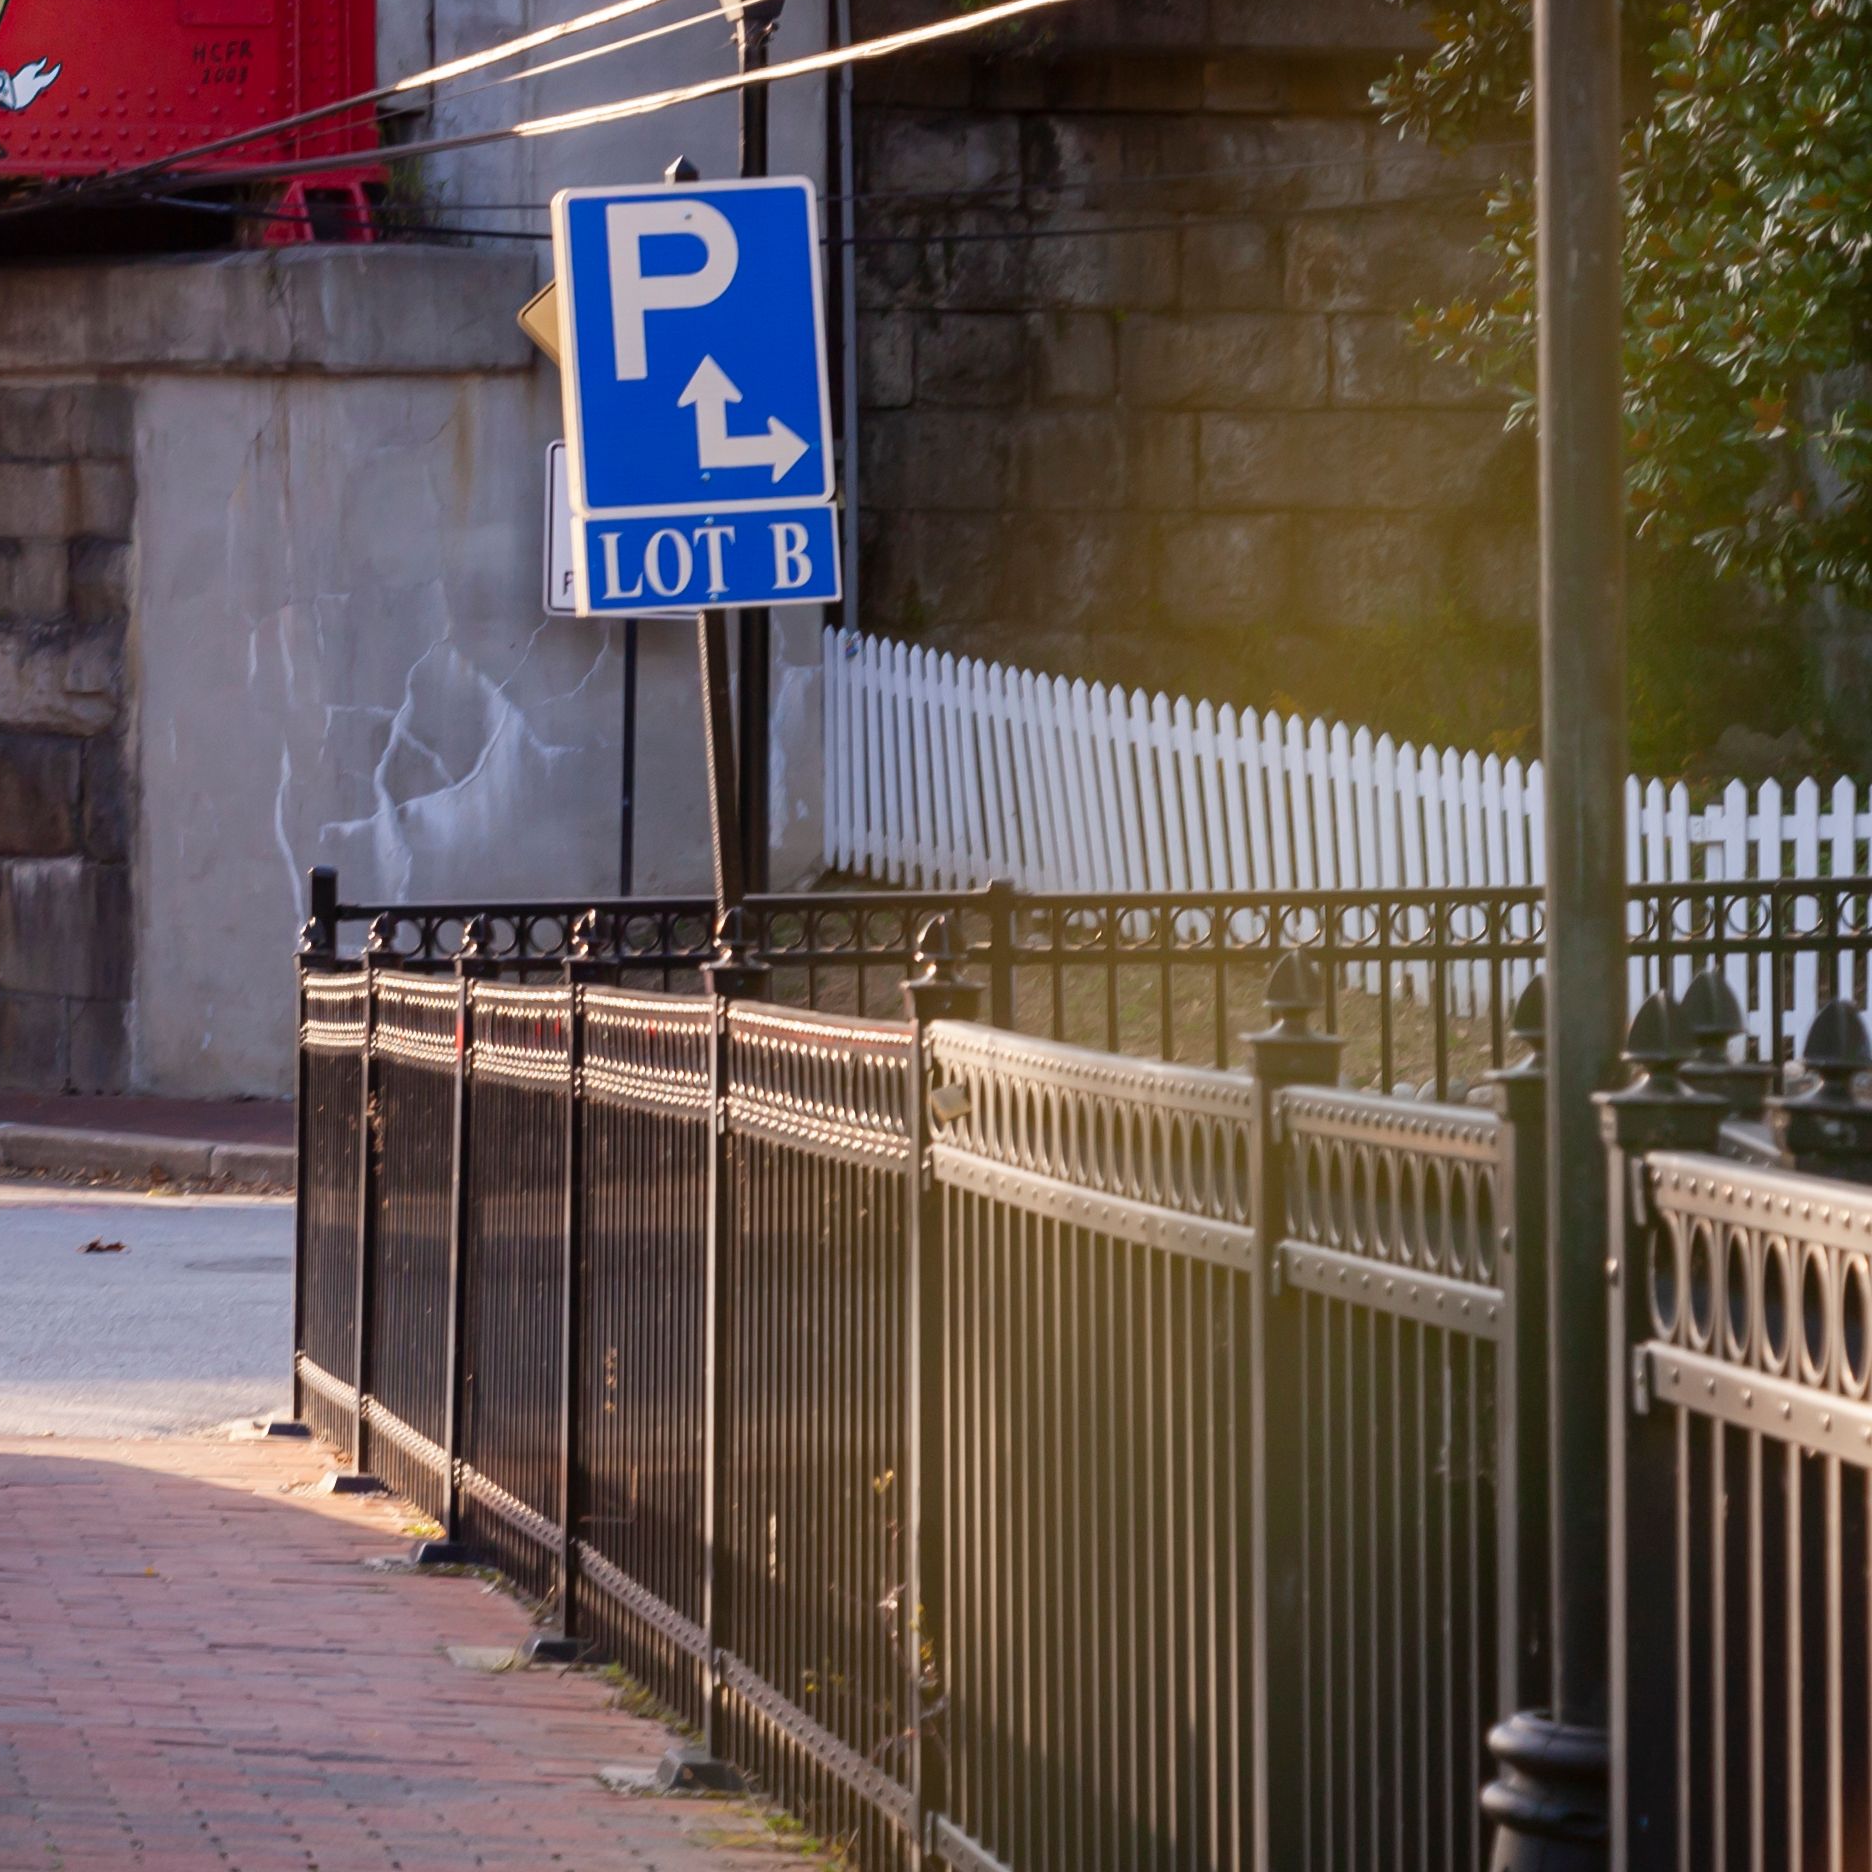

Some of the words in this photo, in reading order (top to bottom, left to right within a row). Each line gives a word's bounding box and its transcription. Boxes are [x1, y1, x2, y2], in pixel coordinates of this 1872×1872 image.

[605, 199, 740, 382] P
[599, 525, 736, 601] LOT
[769, 523, 814, 590] B
